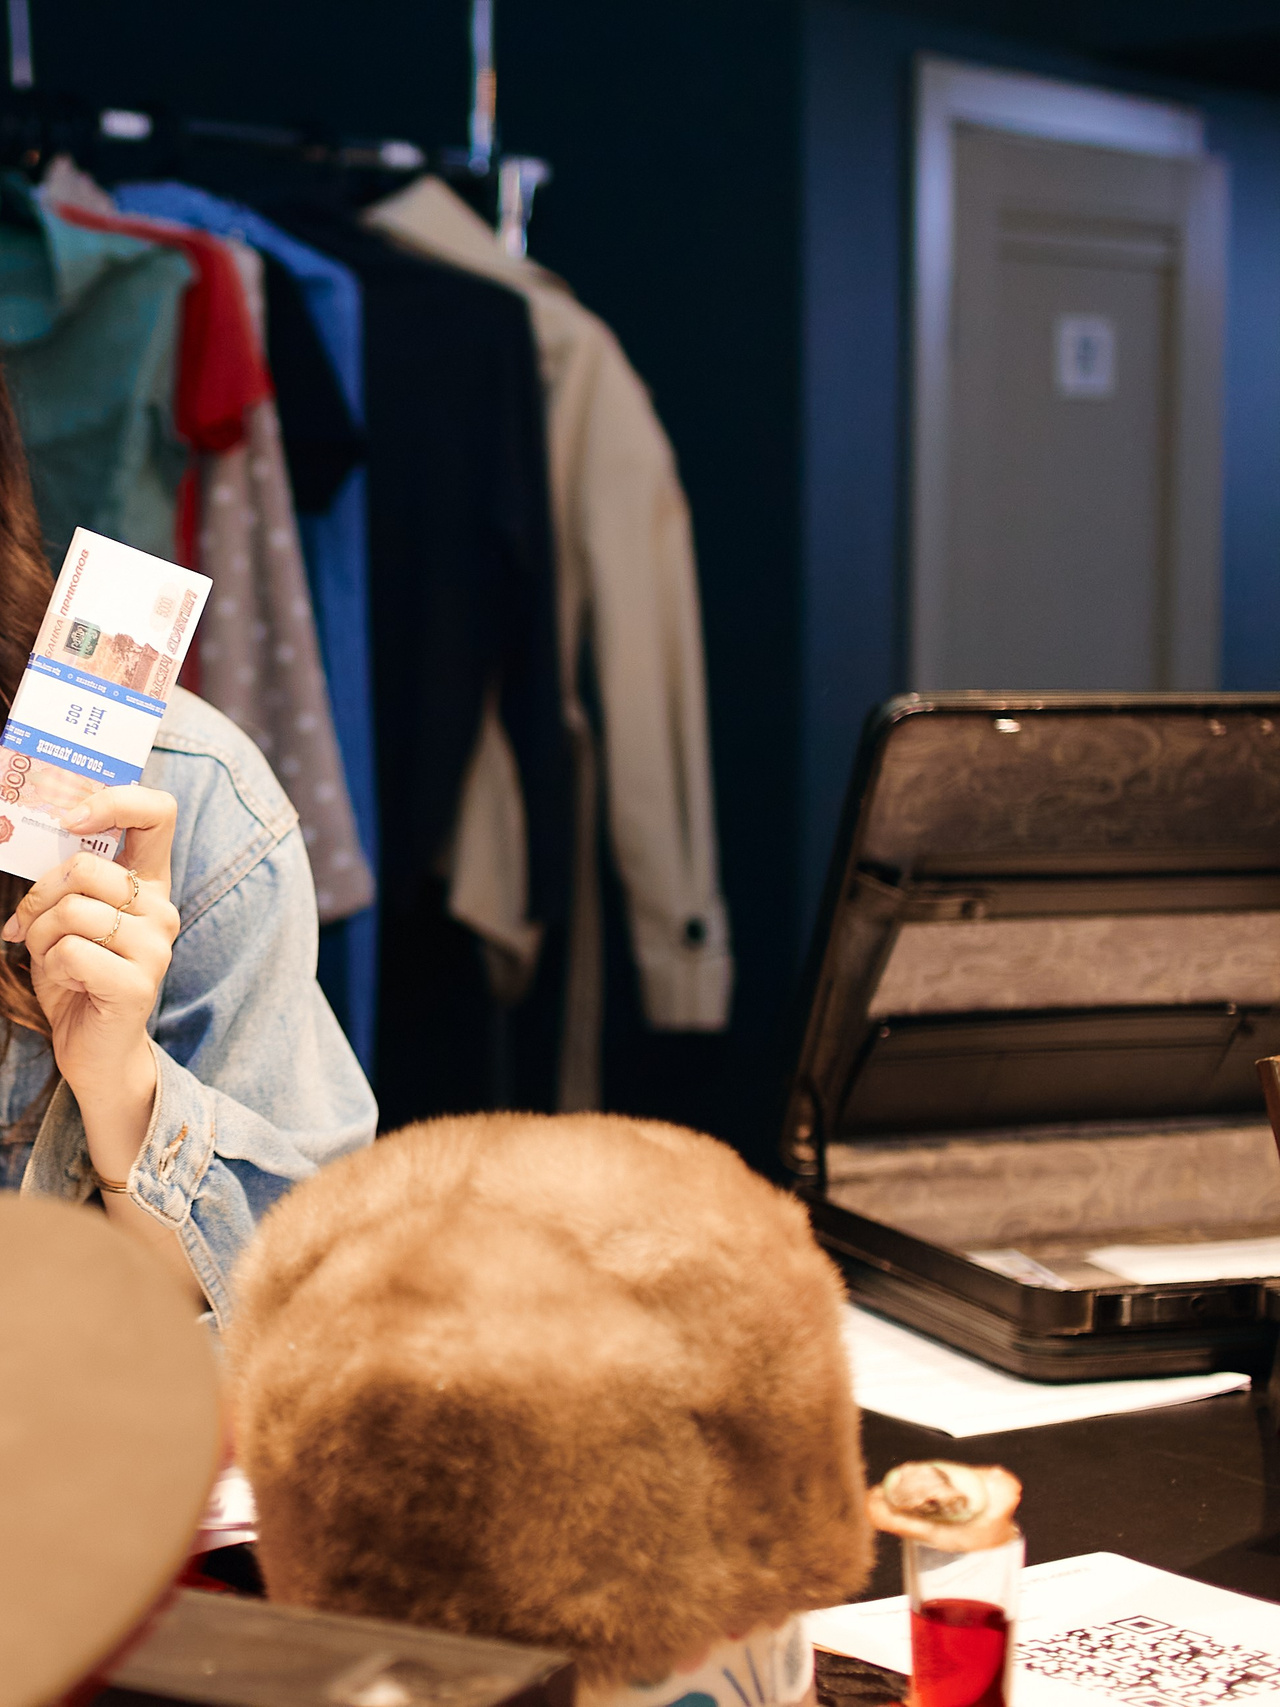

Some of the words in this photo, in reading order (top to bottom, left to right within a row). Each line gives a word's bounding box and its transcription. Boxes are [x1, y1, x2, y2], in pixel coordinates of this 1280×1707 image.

[43, 619, 64, 658] БАНКА
[59, 547, 89, 616] ПРИКОЛОВ
[148, 653, 173, 699] ЫСЯЧ
[64, 702, 84, 725] 500
[83, 705, 107, 736] ТЫЩ
